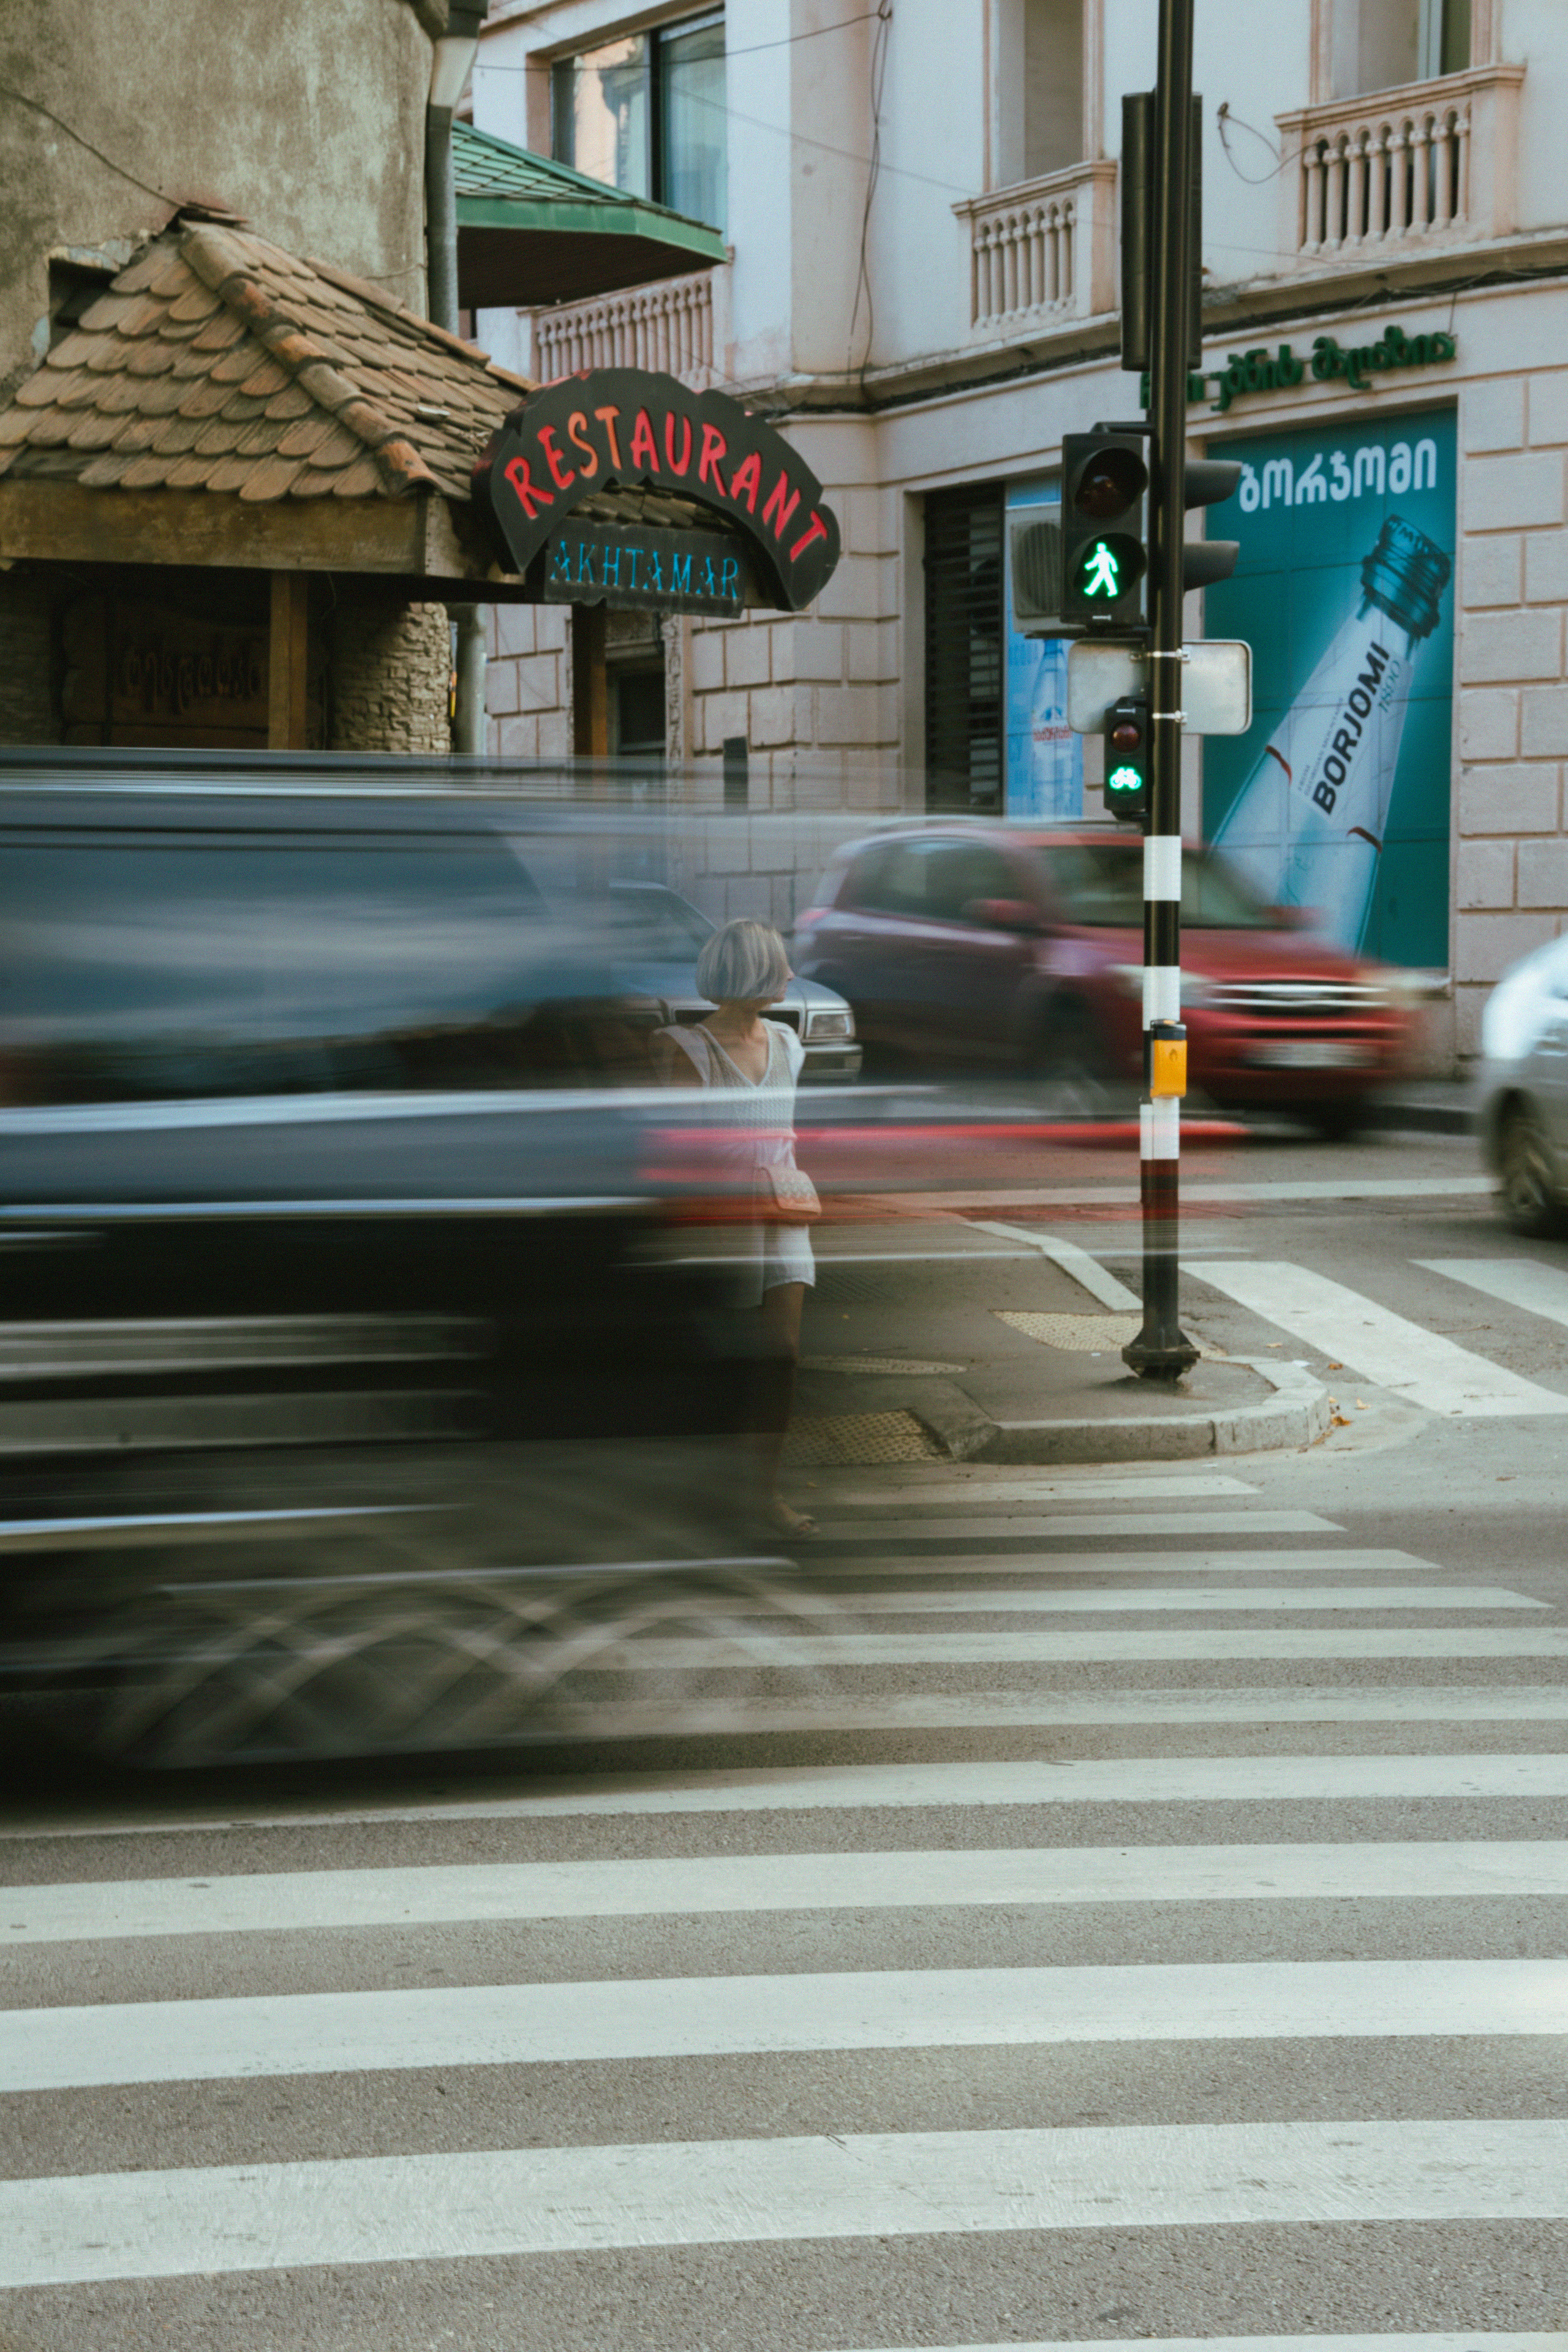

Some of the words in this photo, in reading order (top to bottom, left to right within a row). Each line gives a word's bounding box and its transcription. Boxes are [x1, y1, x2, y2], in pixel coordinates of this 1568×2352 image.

[1312, 325, 1456, 390] მაღაზია
[504, 405, 827, 562] RESTAURANT
[1240, 439, 1437, 512] ბორჯომი
[551, 540, 739, 598] AKHTAMAR
[1312, 641, 1390, 815] BORJOMI
